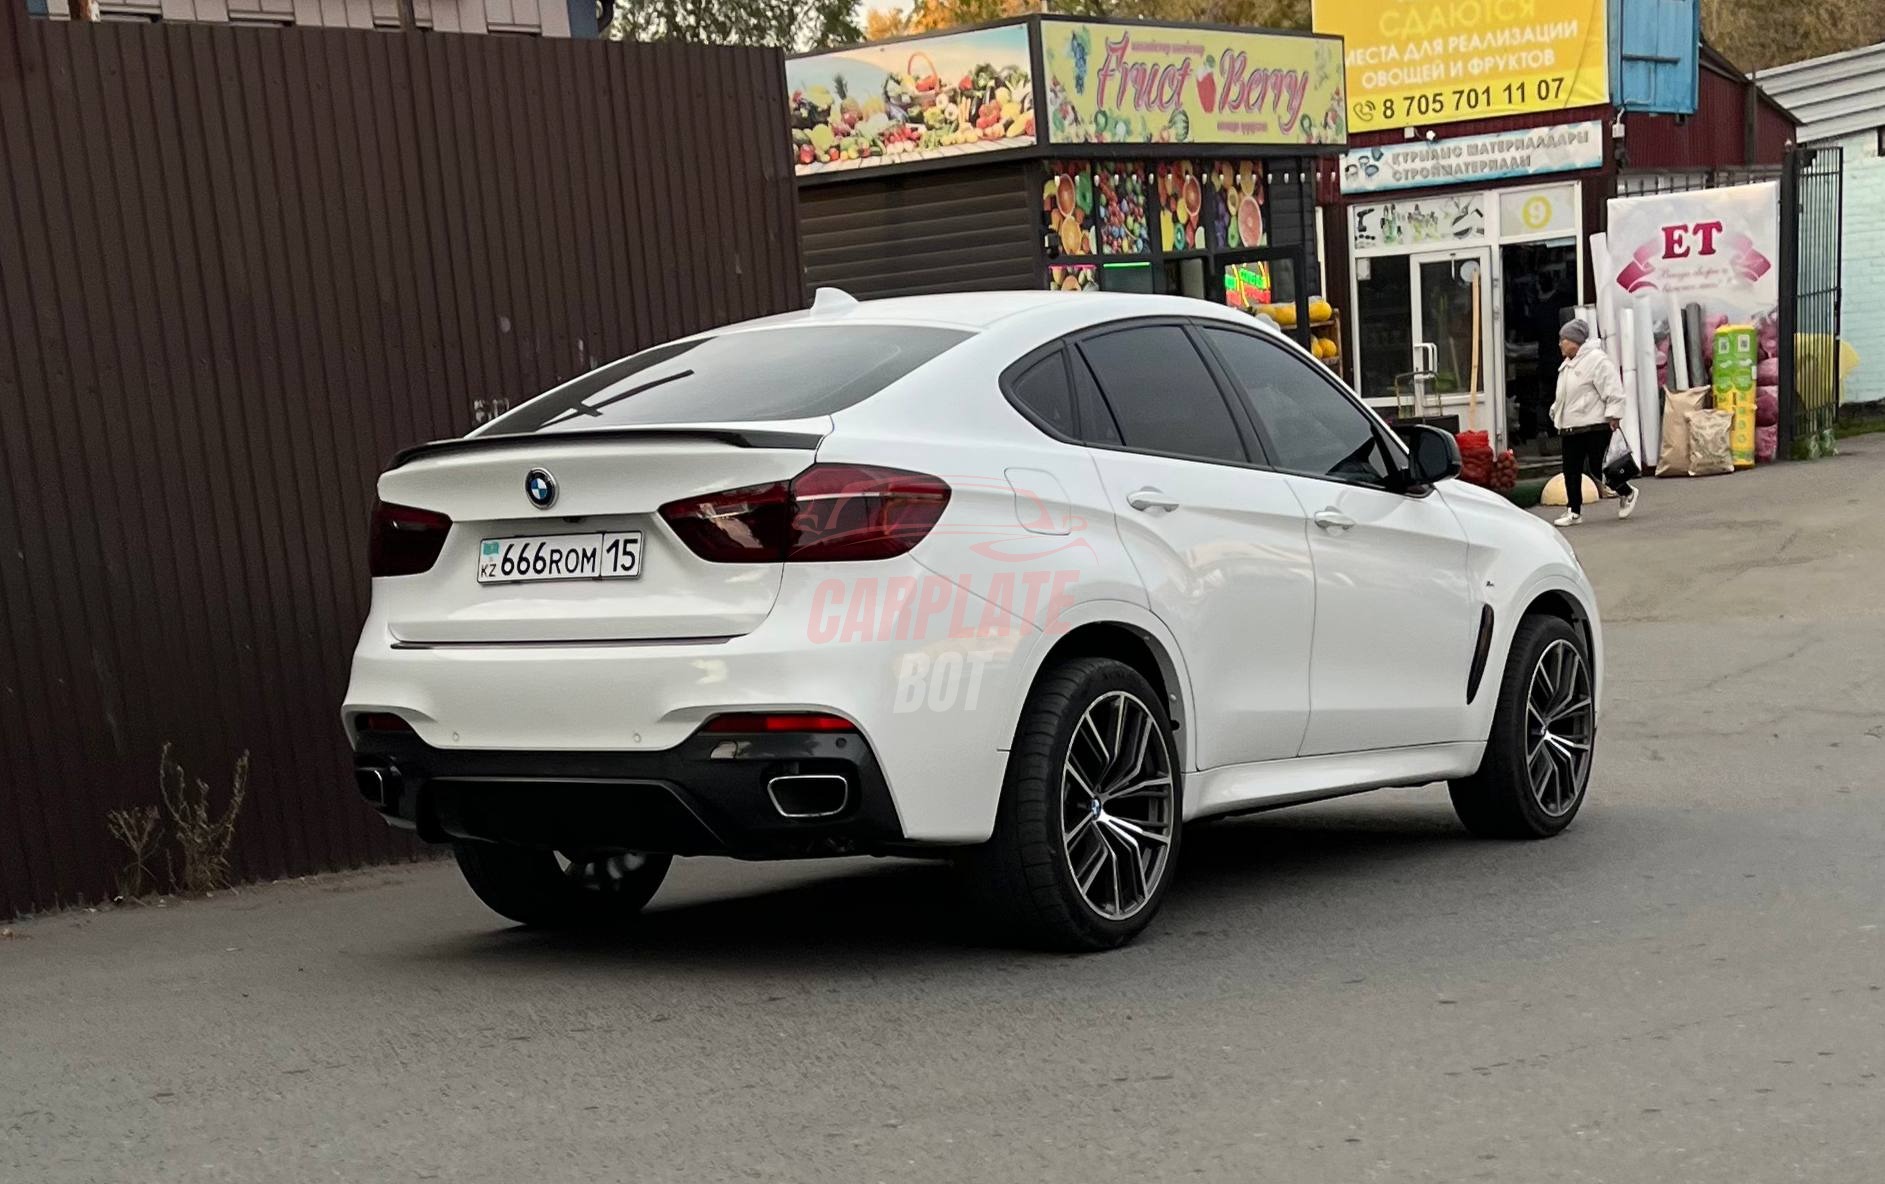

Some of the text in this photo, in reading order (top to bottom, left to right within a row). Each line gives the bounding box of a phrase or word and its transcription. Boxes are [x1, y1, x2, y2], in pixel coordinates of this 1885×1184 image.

[1403, 37, 1443, 62] ДЛЯ
[1448, 19, 1579, 53] РЕАЛИЗАЦИИ
[1361, 48, 1555, 90] ОВОЩЕЙ И ФРУКТОВ
[1217, 48, 1310, 135] Berry
[1382, 77, 1565, 119] 8 705 701 11 07
[480, 538, 639, 578] KZ 666ROM 15
